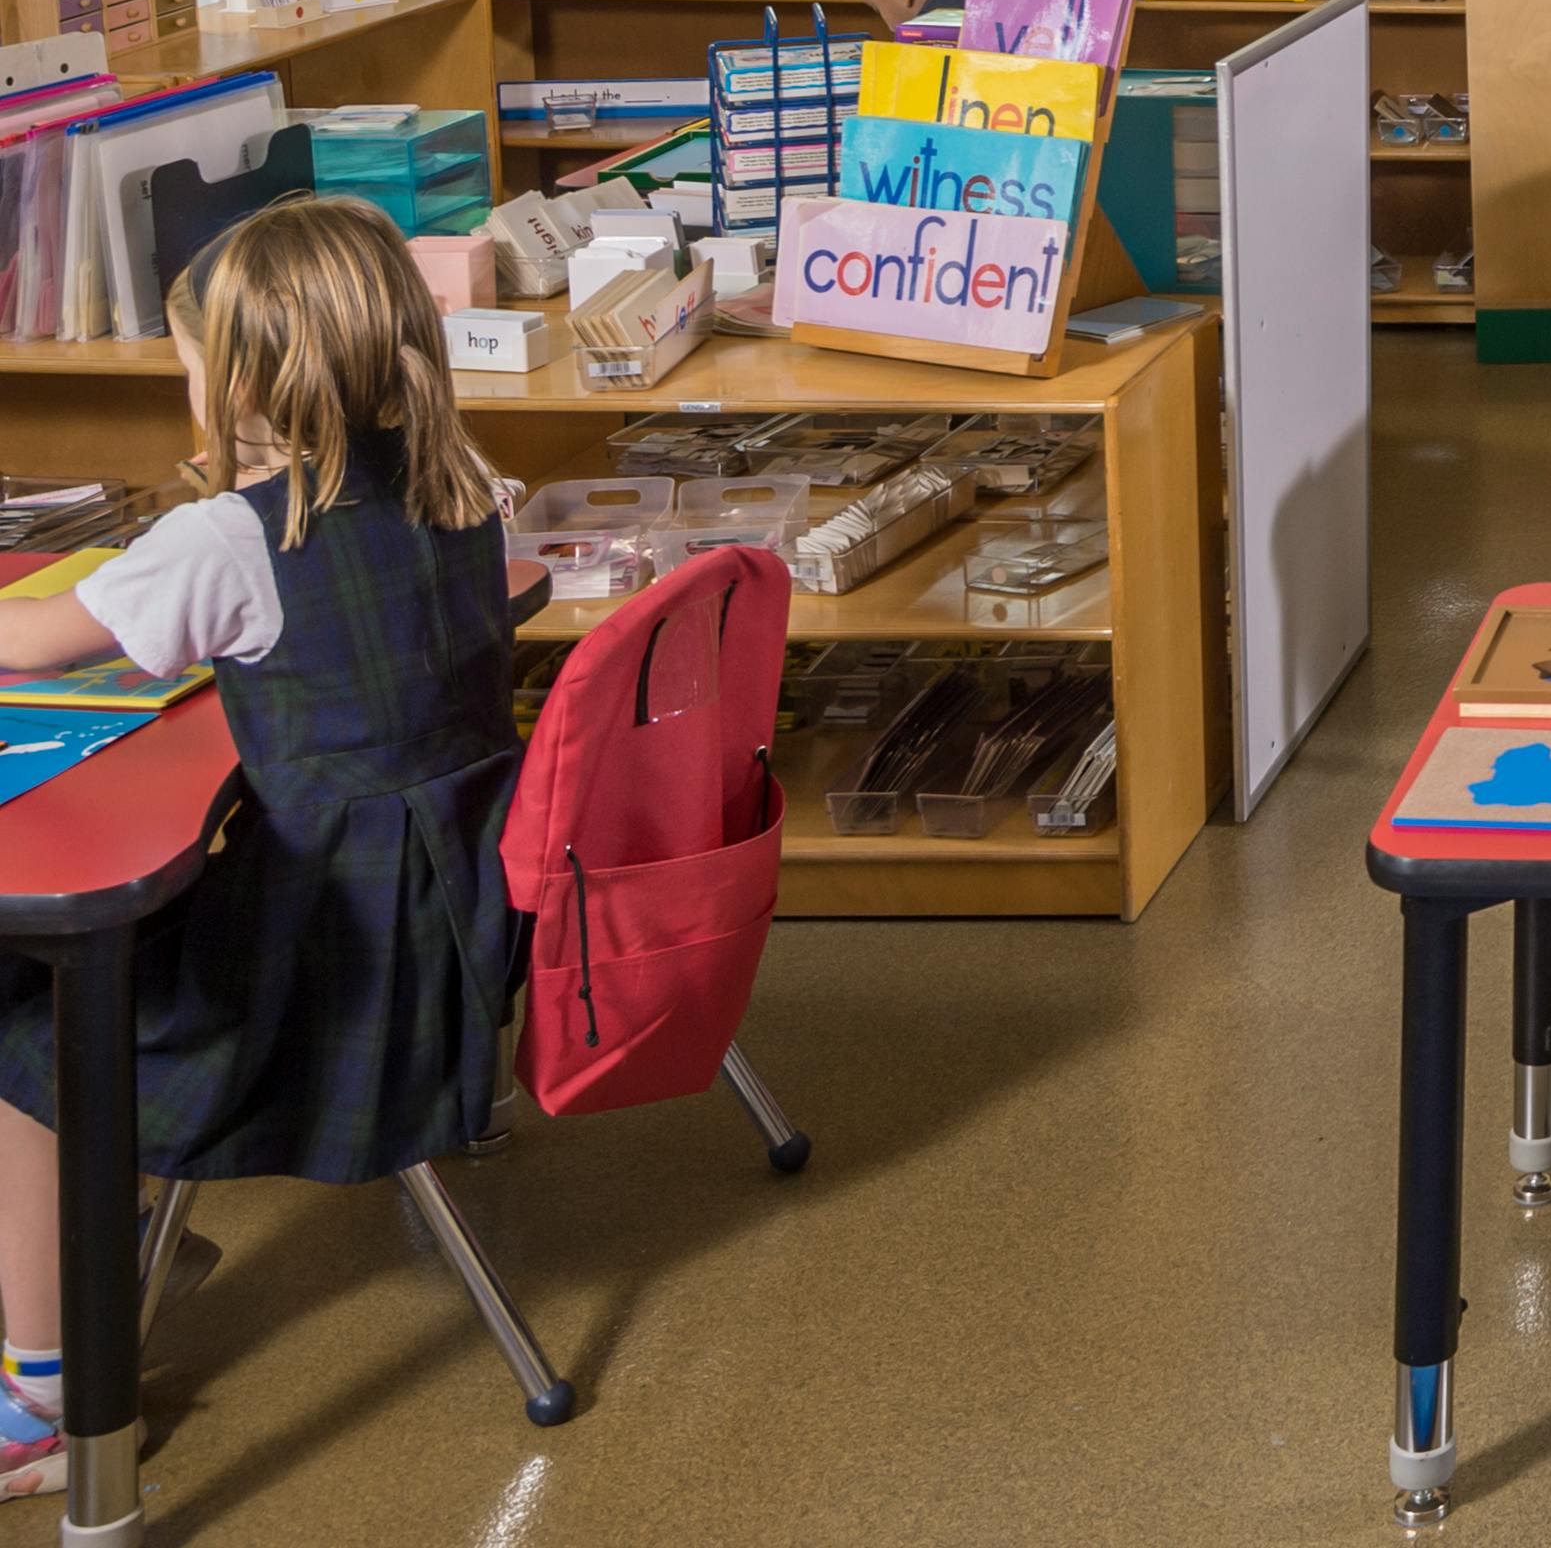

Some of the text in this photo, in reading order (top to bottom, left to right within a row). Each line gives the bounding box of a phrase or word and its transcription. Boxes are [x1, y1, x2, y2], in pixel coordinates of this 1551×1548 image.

[601, 88, 622, 103] the
[935, 55, 1055, 137] linen
[859, 137, 1056, 220] witness
[803, 216, 1060, 314] confident
[467, 331, 499, 355] hop
